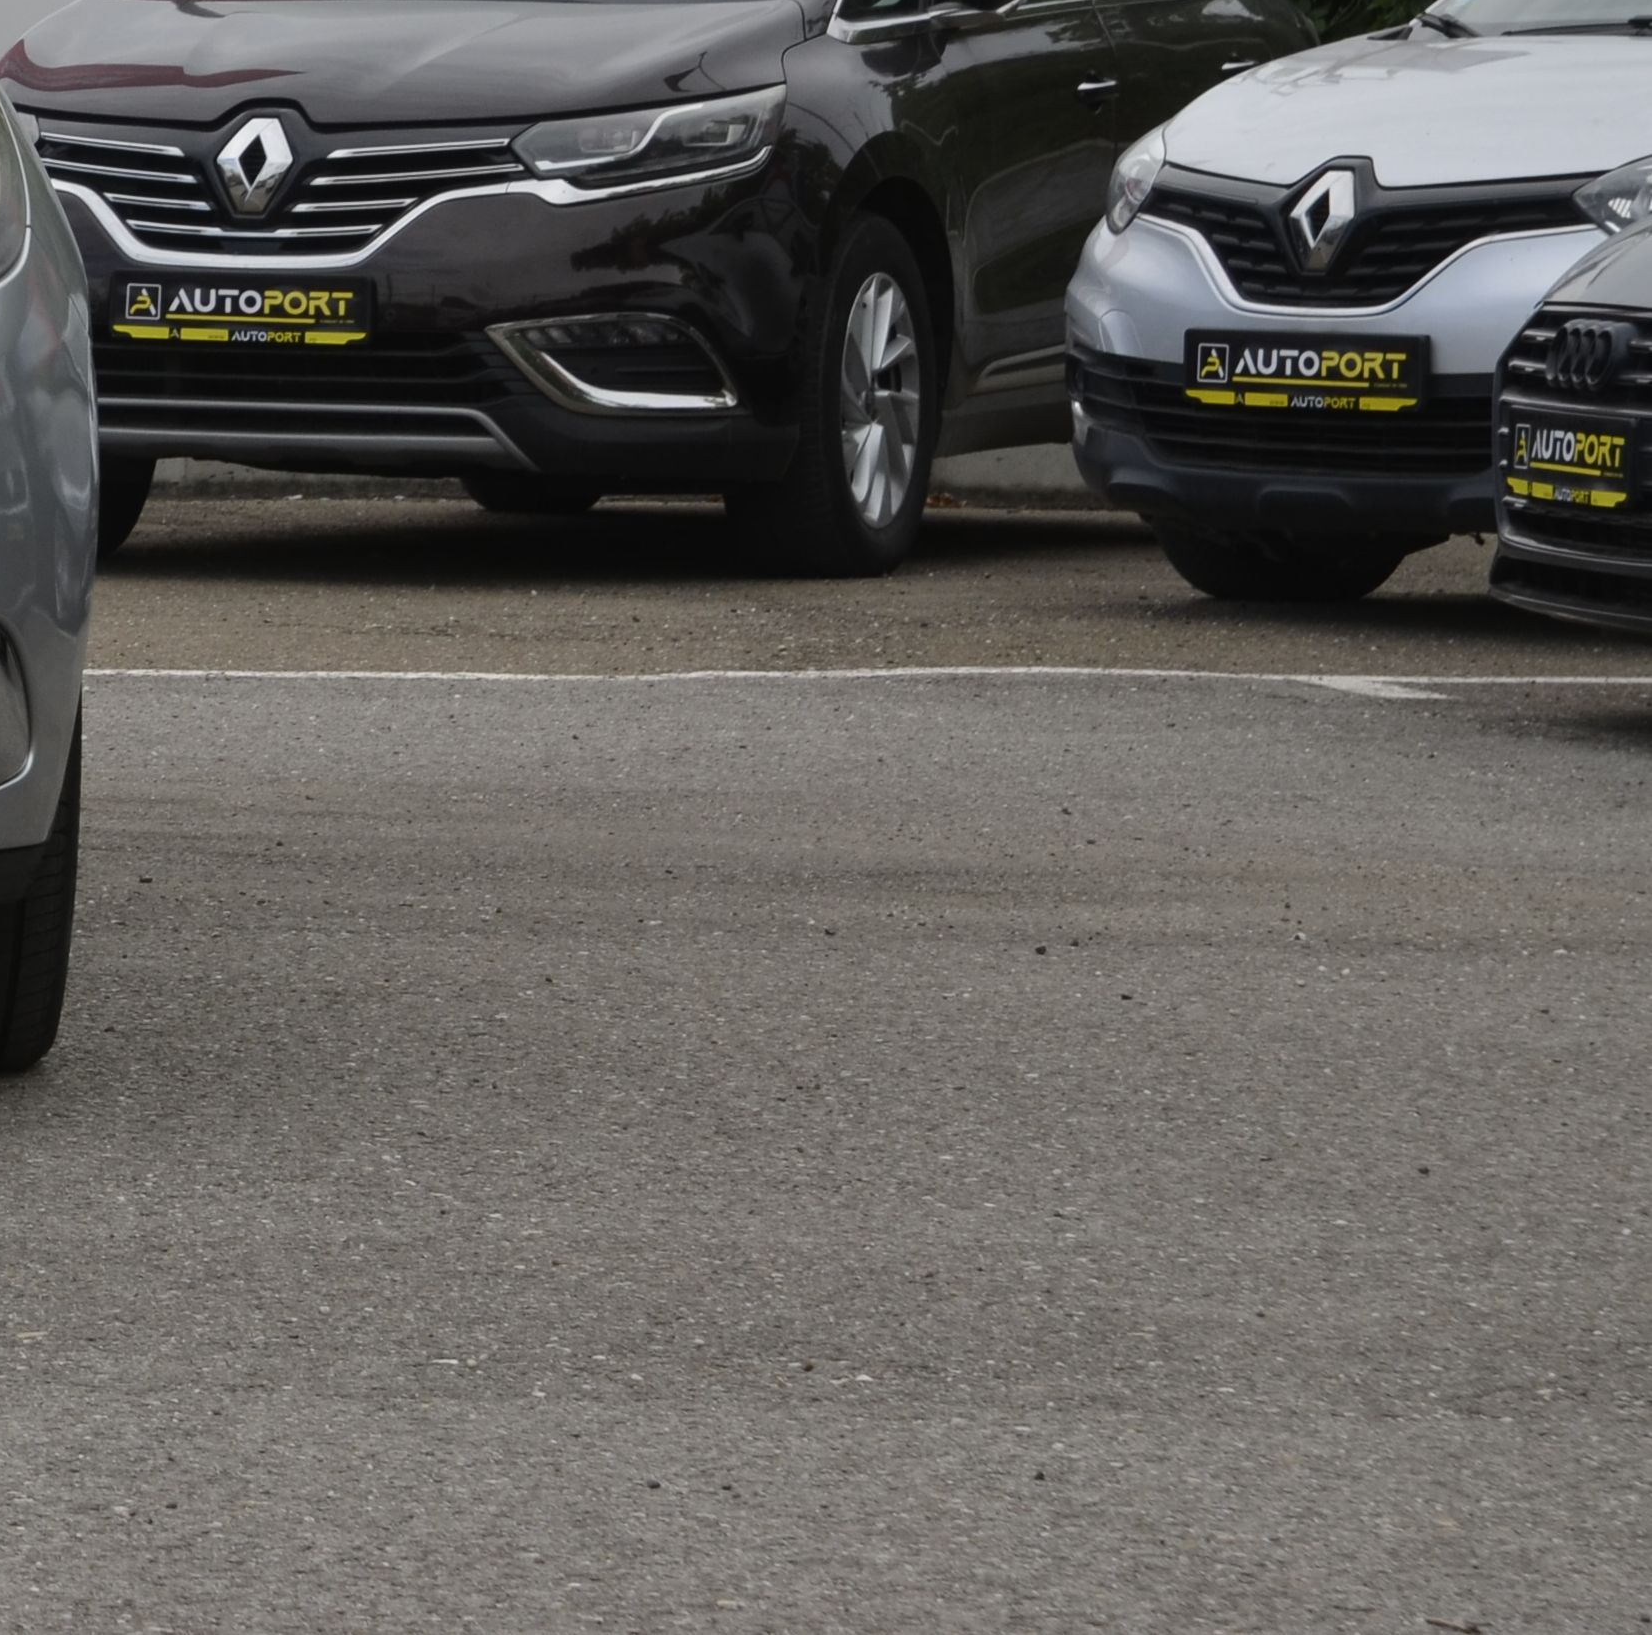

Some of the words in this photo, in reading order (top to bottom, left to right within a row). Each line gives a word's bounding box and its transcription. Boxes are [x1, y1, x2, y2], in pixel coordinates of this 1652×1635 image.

[168, 288, 354, 316] AUTOPORT
[231, 330, 301, 343] AUTOPORT
[1235, 348, 1407, 379] AUTOPORT
[1290, 394, 1356, 409] AUTOPORT
[1531, 429, 1625, 468] AUTOPORT
